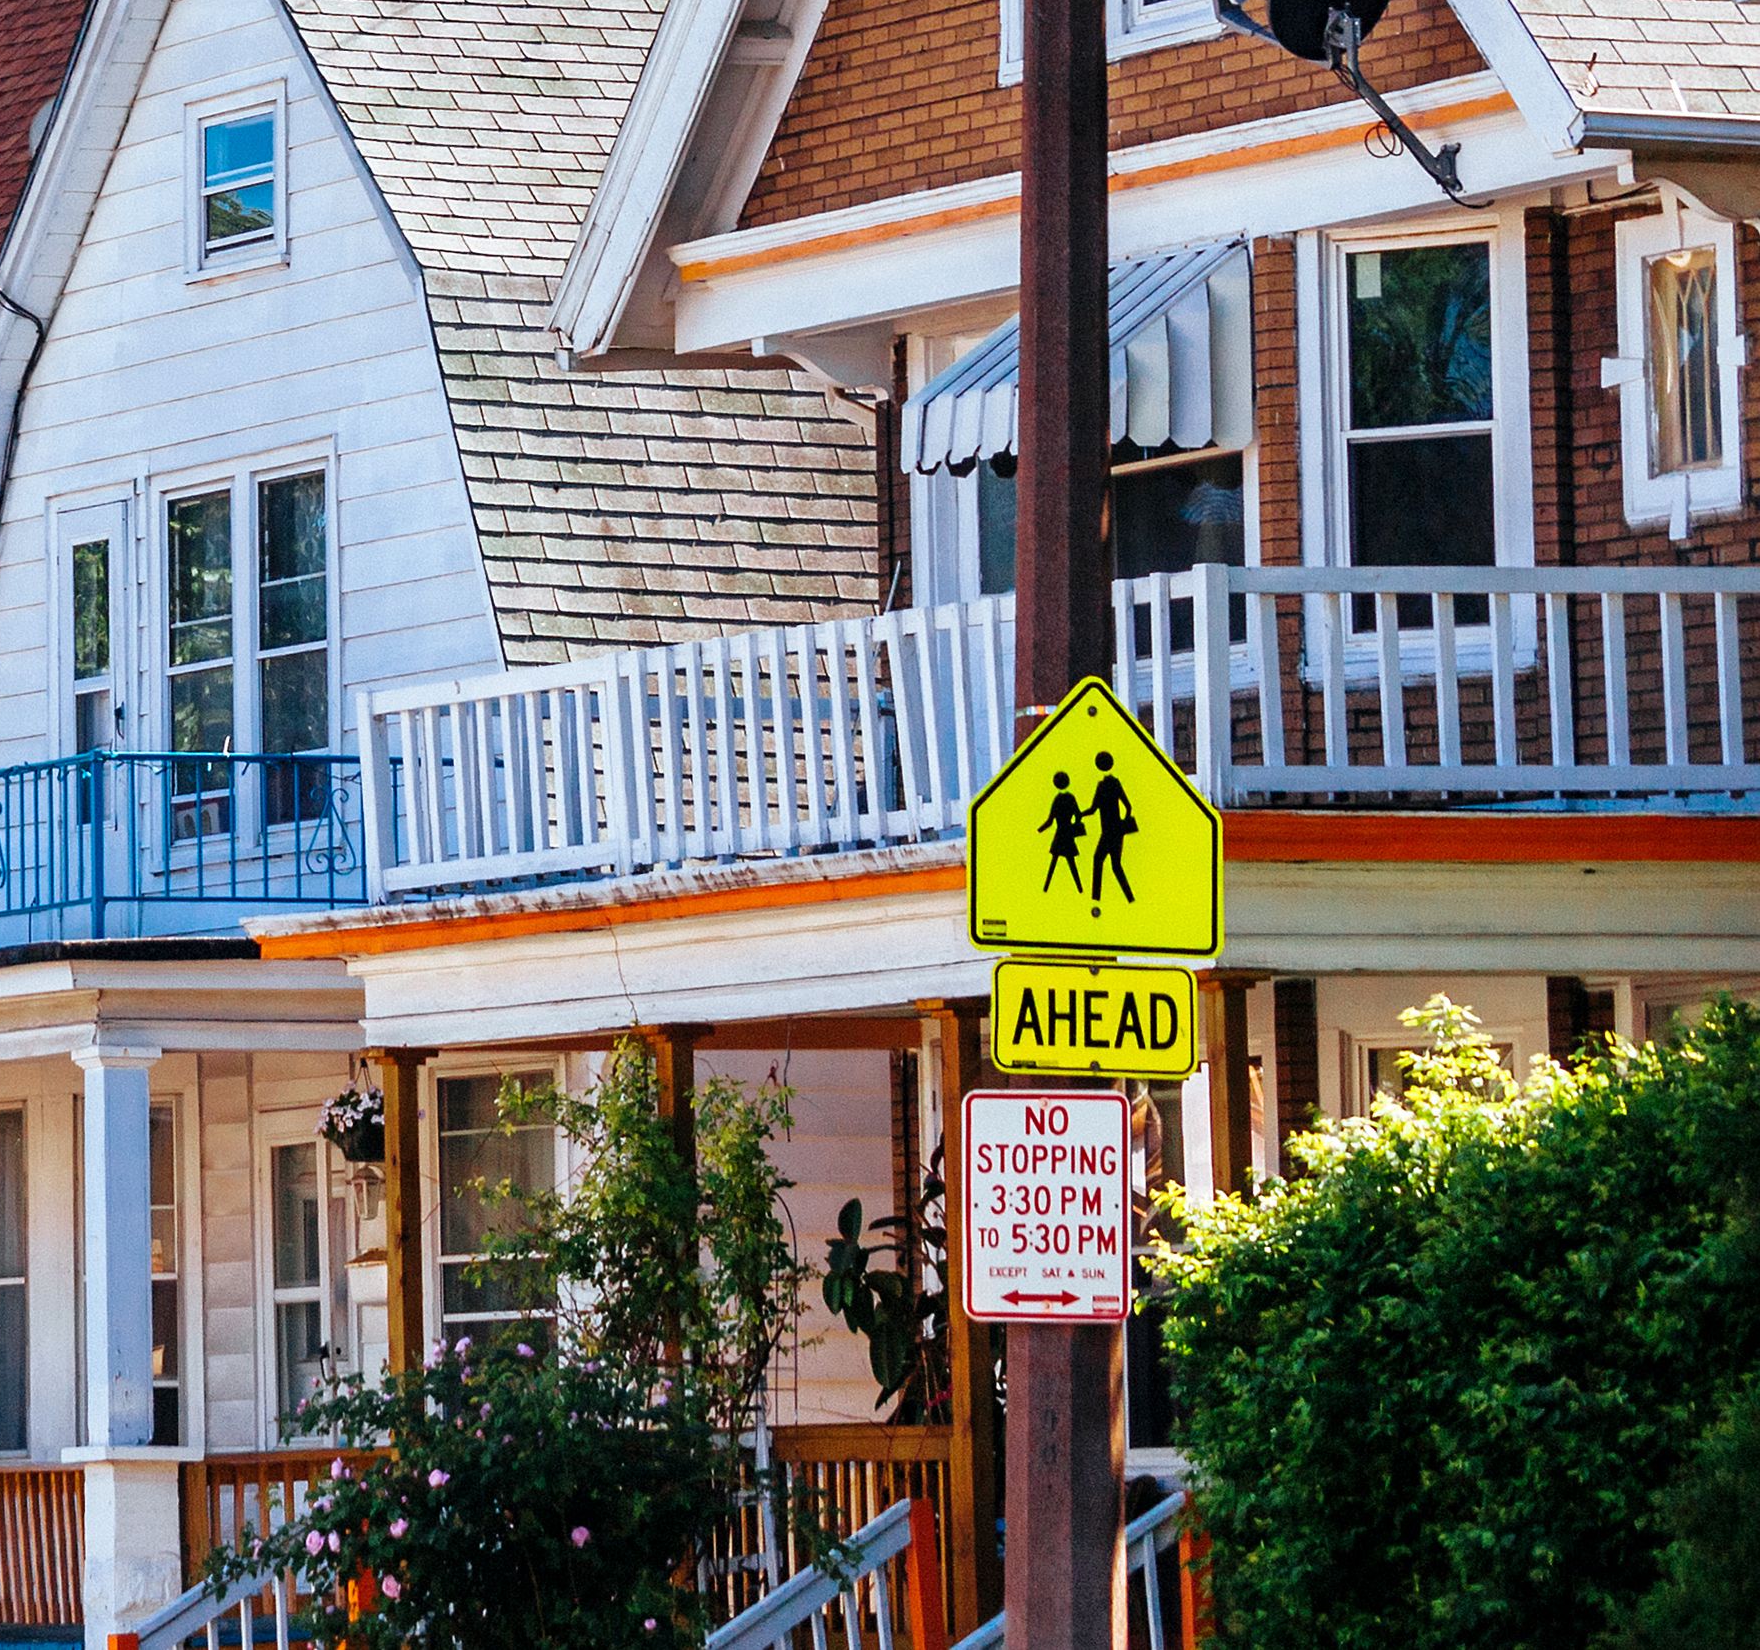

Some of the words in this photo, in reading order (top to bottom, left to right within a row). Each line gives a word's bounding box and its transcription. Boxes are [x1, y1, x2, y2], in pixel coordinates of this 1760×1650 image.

[1012, 987, 1178, 1050] AHEAD
[1025, 1105, 1069, 1136] NO
[977, 1143, 1116, 1175] STOPPING
[990, 1184, 1051, 1215] 3:30
[1061, 1185, 1101, 1216] PM
[978, 1227, 999, 1248] TO
[1011, 1223, 1070, 1254] 5:30
[1078, 1224, 1117, 1255] PM
[989, 1266, 1027, 1278] EXCEPT
